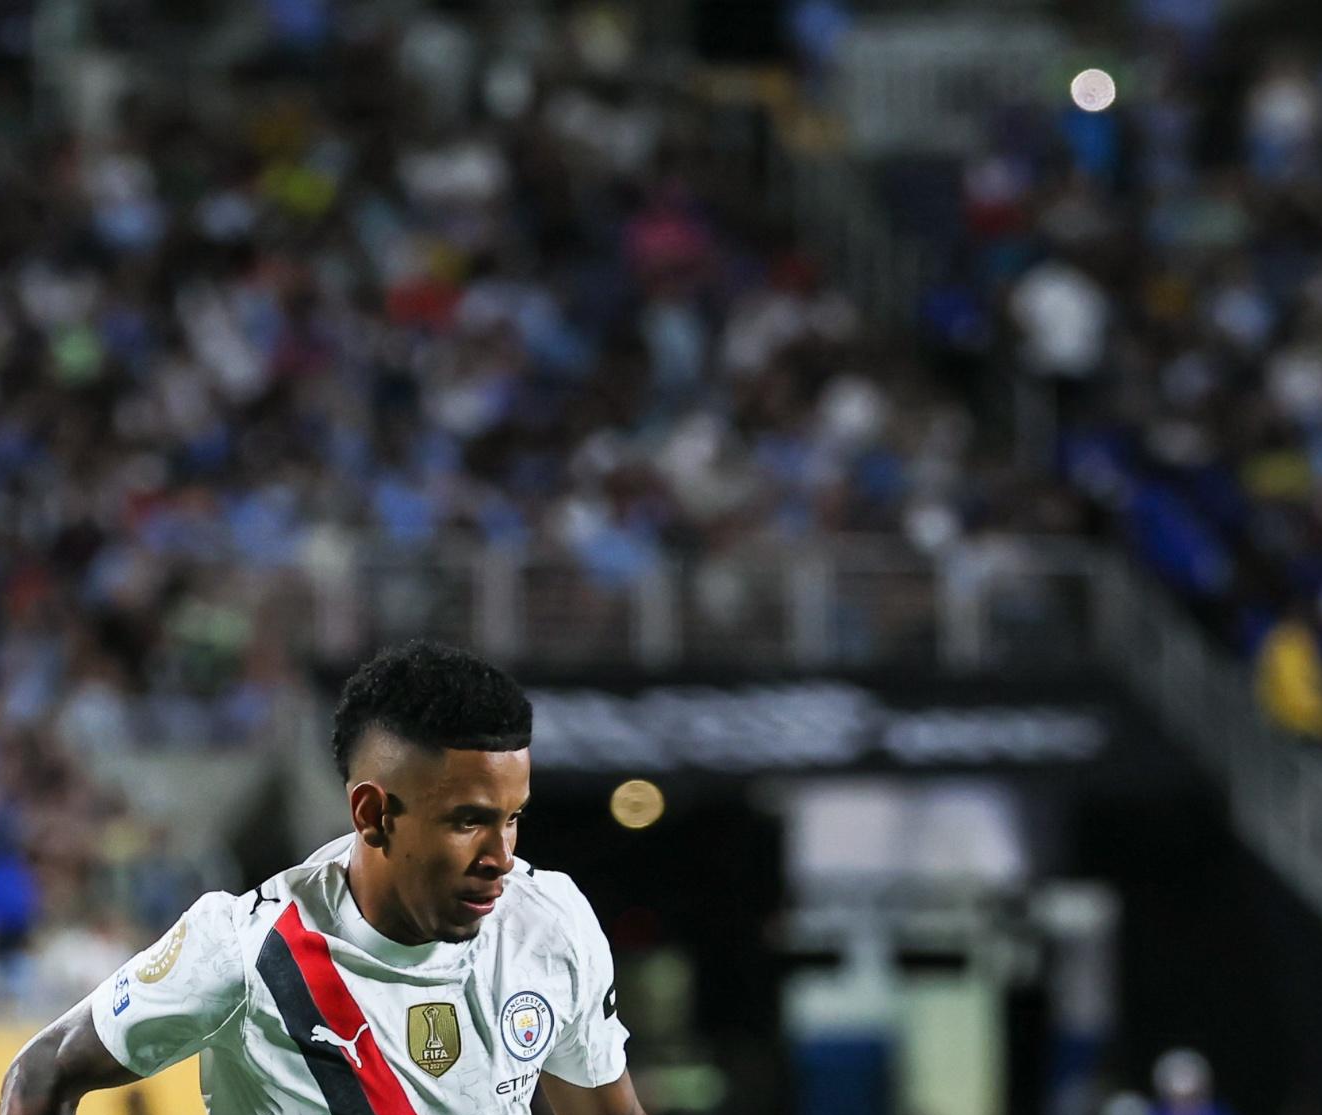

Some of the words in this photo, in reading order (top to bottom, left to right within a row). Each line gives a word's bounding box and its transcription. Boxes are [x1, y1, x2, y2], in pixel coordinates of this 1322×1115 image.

[505, 996, 547, 1021] MANCHESTER
[423, 1049, 448, 1060] FIFA
[523, 1047, 537, 1057] CITY
[496, 1067, 540, 1094] ETIHA
